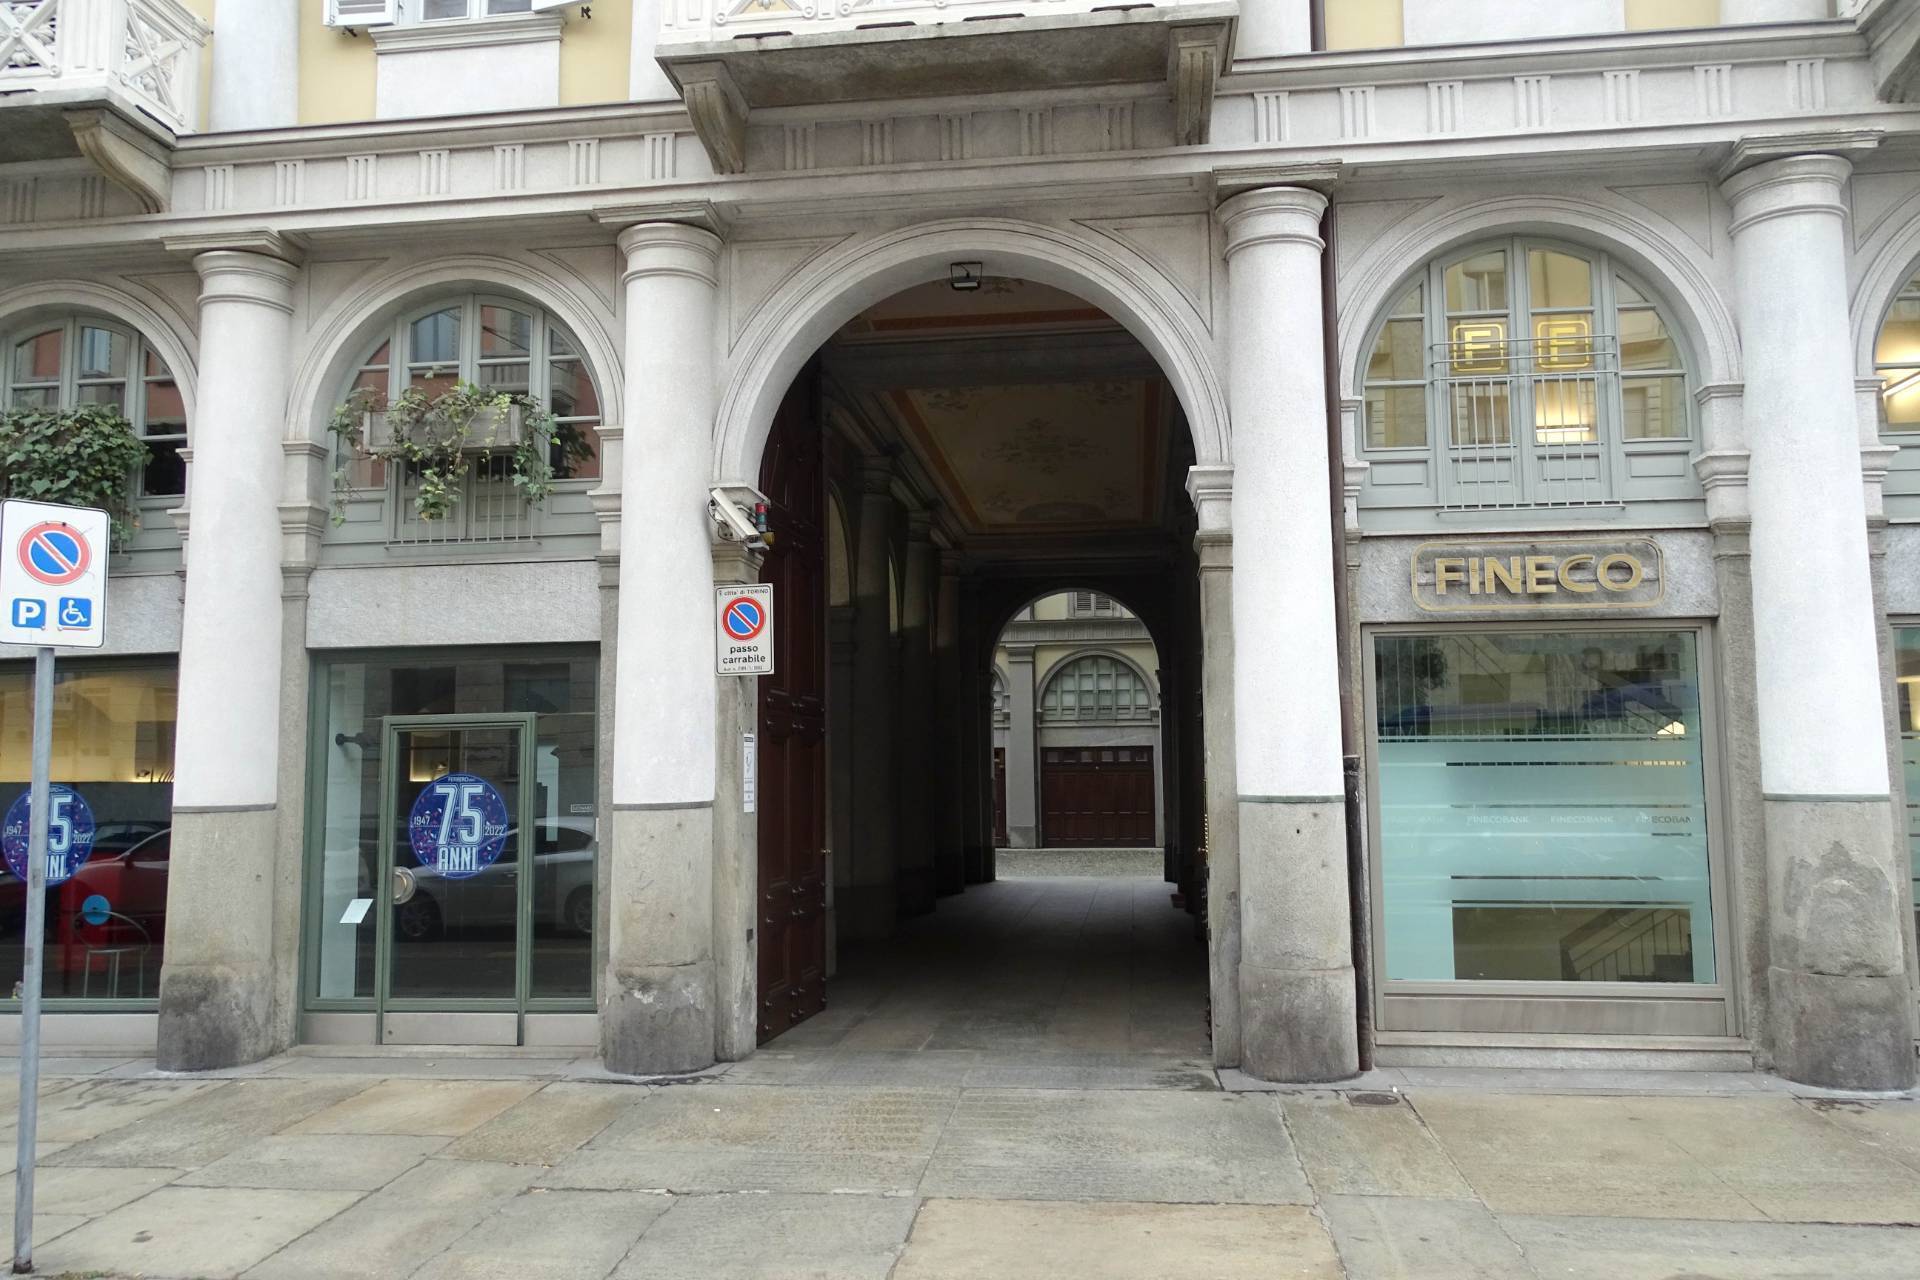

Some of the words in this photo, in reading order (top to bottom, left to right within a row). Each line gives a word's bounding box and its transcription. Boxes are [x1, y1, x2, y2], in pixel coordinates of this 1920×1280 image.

[1465, 330, 1491, 364] F
[1549, 327, 1577, 361] F
[1435, 554, 1642, 594] FINECO
[18, 601, 41, 624] P
[722, 654, 766, 664] carrabile
[730, 645, 758, 654] passo
[413, 816, 431, 826] 1947
[434, 784, 484, 845] 75
[6, 825, 22, 835] 1947
[484, 825, 505, 836] 2022
[438, 846, 477, 871] ANNI
